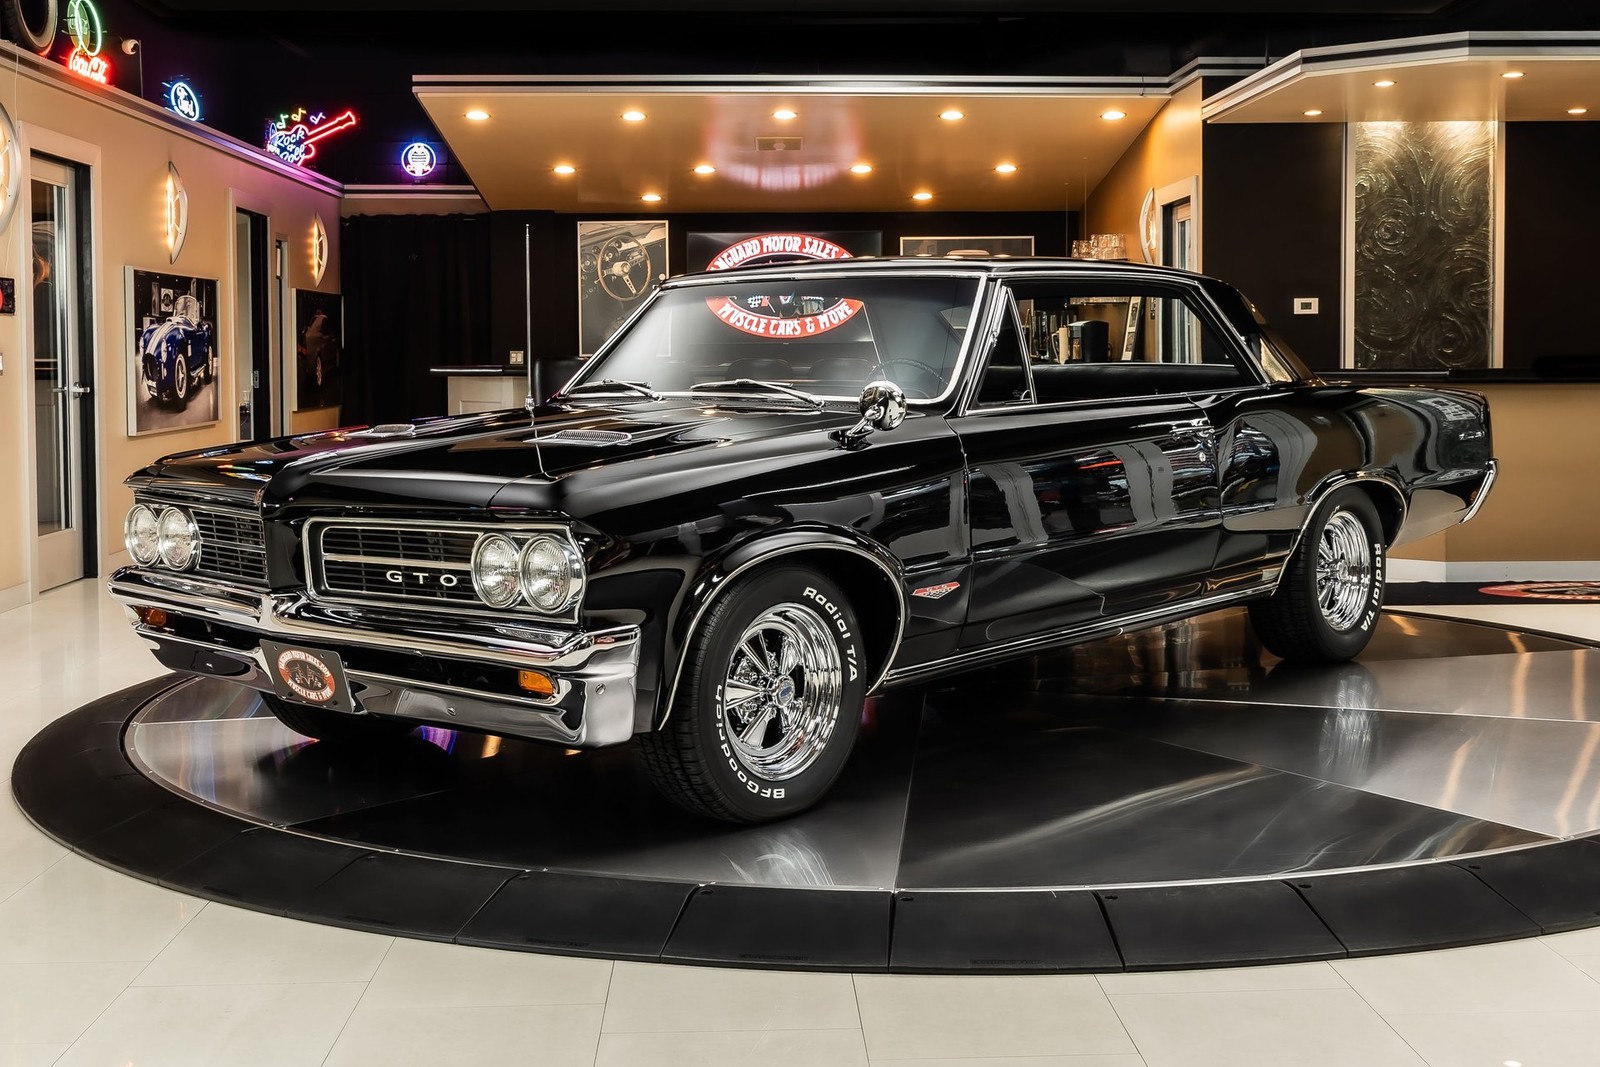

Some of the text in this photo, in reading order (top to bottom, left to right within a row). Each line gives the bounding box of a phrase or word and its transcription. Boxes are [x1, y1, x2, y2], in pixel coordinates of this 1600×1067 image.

[275, 127, 305, 147] Rock
[763, 235, 801, 252] MOTOR
[718, 301, 854, 335] MUSCLE CARS & MORE
[386, 570, 458, 587] GTO
[1360, 543, 1382, 632] Radial T/A
[803, 586, 858, 682] Radial T/A
